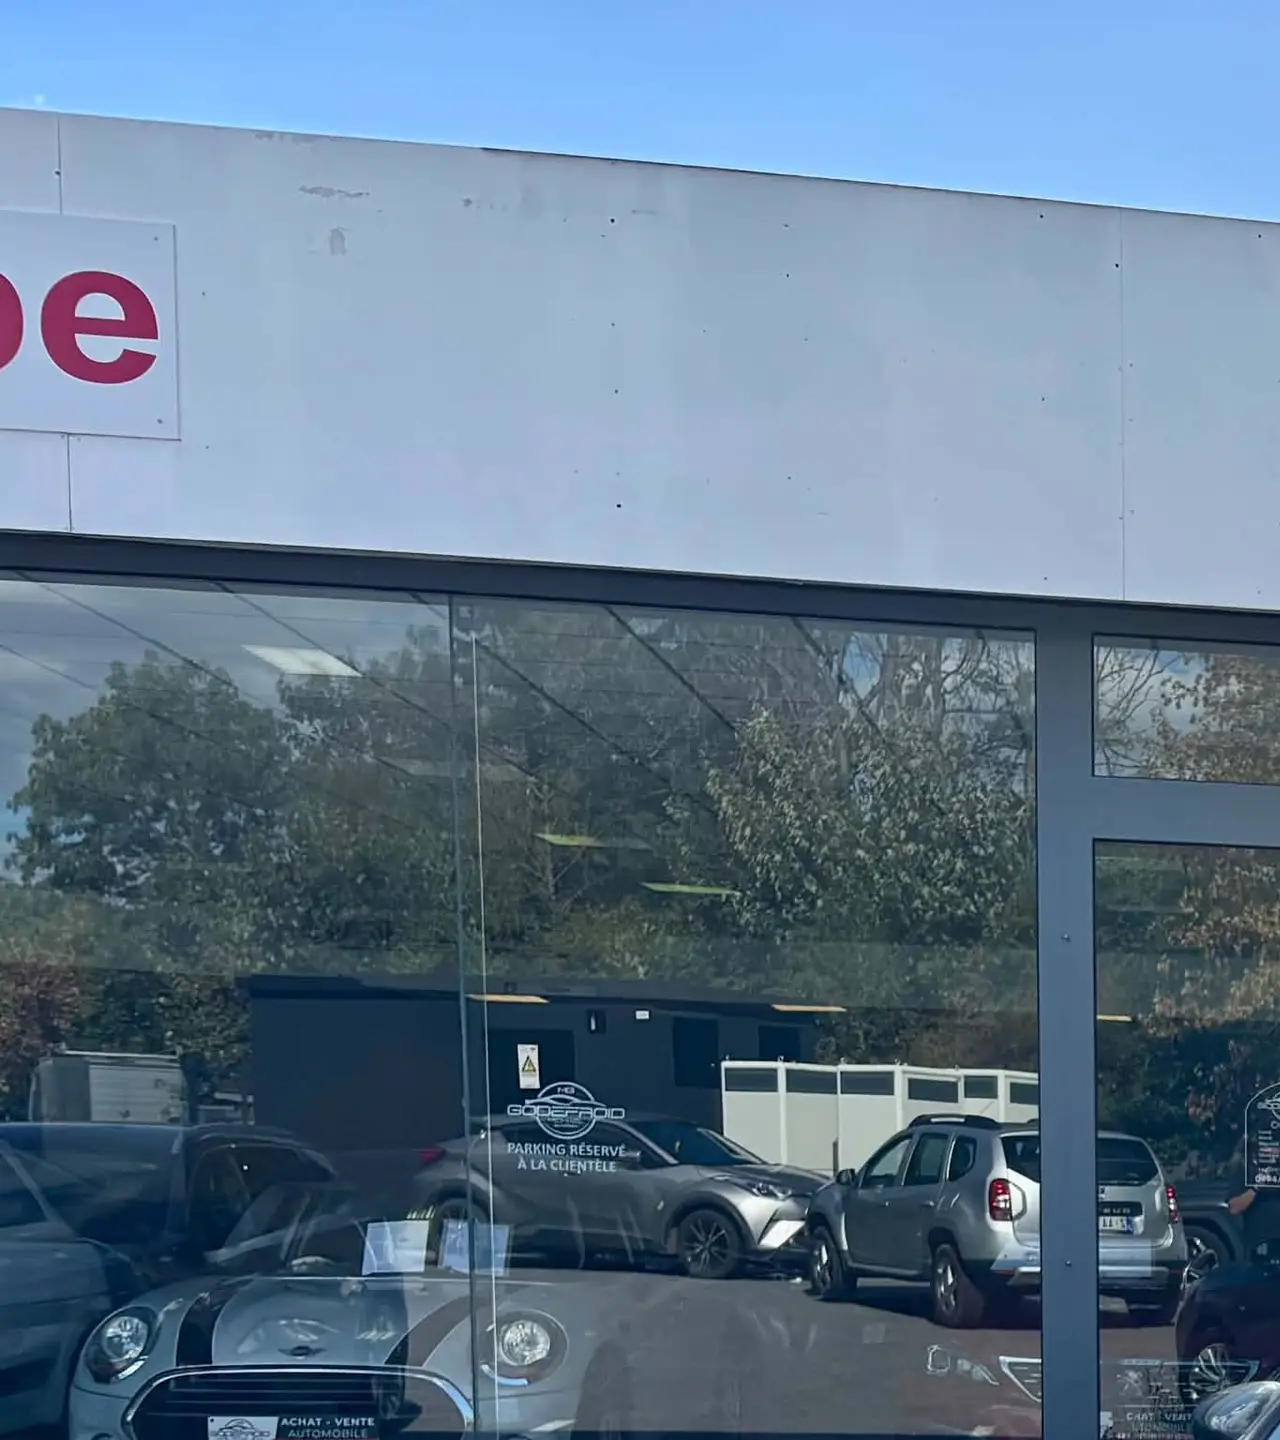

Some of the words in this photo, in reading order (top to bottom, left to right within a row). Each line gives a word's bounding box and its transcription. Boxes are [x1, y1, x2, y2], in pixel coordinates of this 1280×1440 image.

[506, 1104, 626, 1119] GODEFROID
[507, 1142, 566, 1156] PARKING
[569, 1142, 627, 1157] RÉSERVÉ
[530, 1160, 547, 1171] LA
[281, 1417, 322, 1427] ACHAT
[335, 1417, 375, 1427] VENTE
[288, 1428, 368, 1438] AUTOMOBILE
